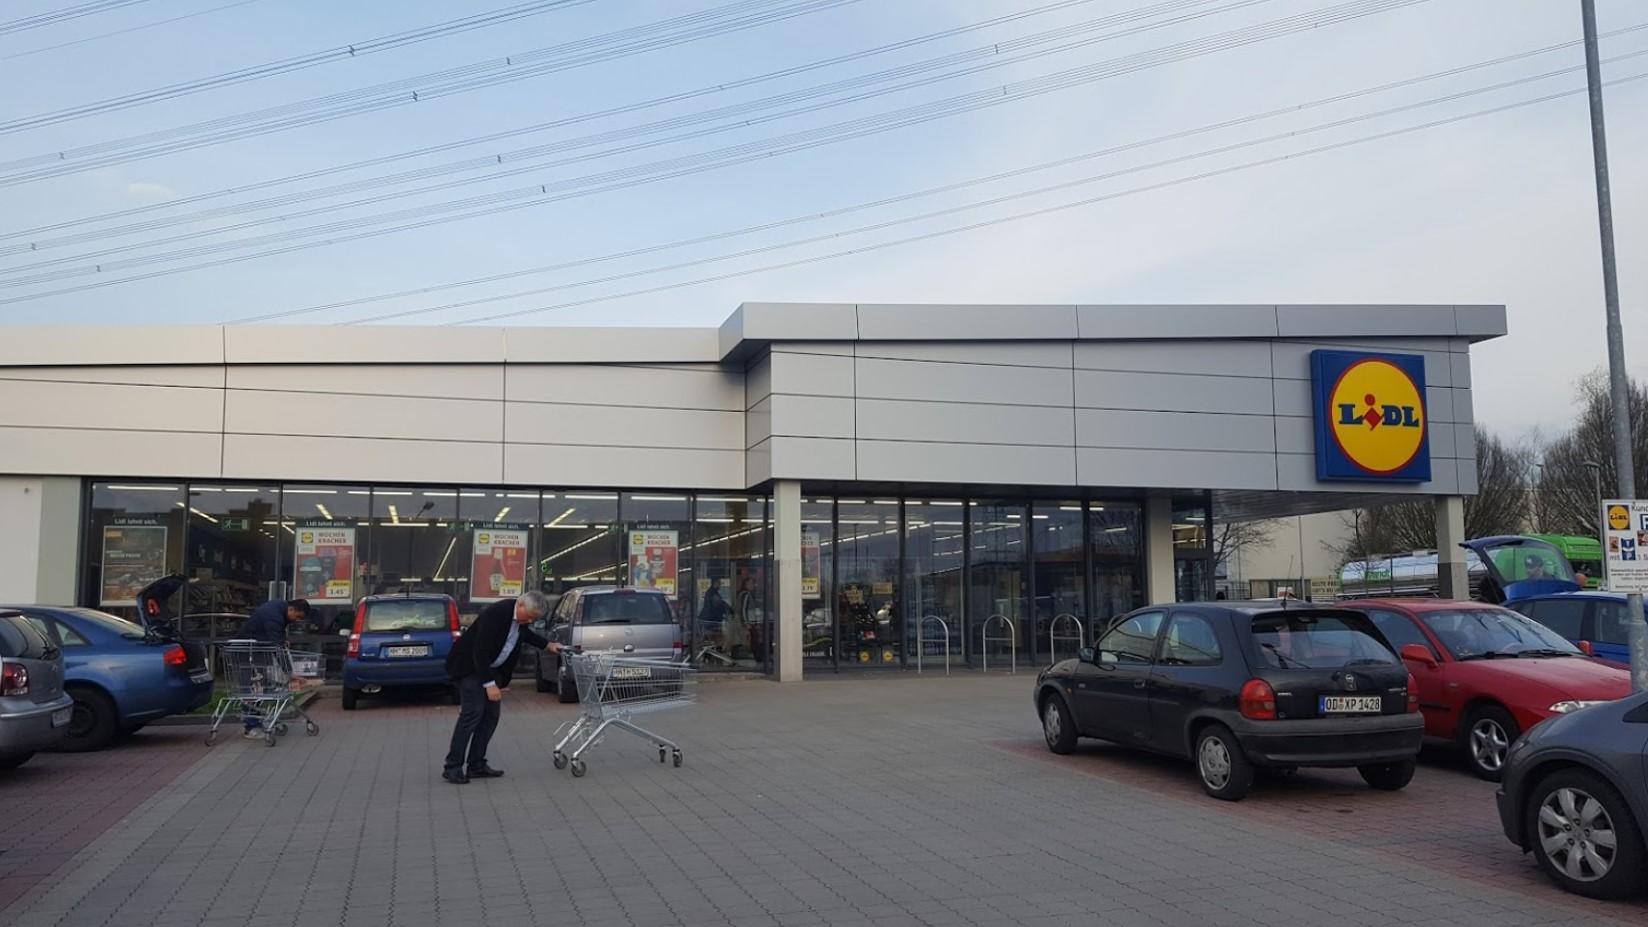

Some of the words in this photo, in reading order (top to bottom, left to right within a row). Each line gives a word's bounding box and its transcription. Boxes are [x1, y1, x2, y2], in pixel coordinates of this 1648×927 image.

[1338, 393, 1420, 431] LIDL
[1610, 513, 1628, 521] LIDL
[1326, 698, 1338, 710] OD
[1344, 698, 1357, 710] XP
[1358, 698, 1380, 710] 1428
